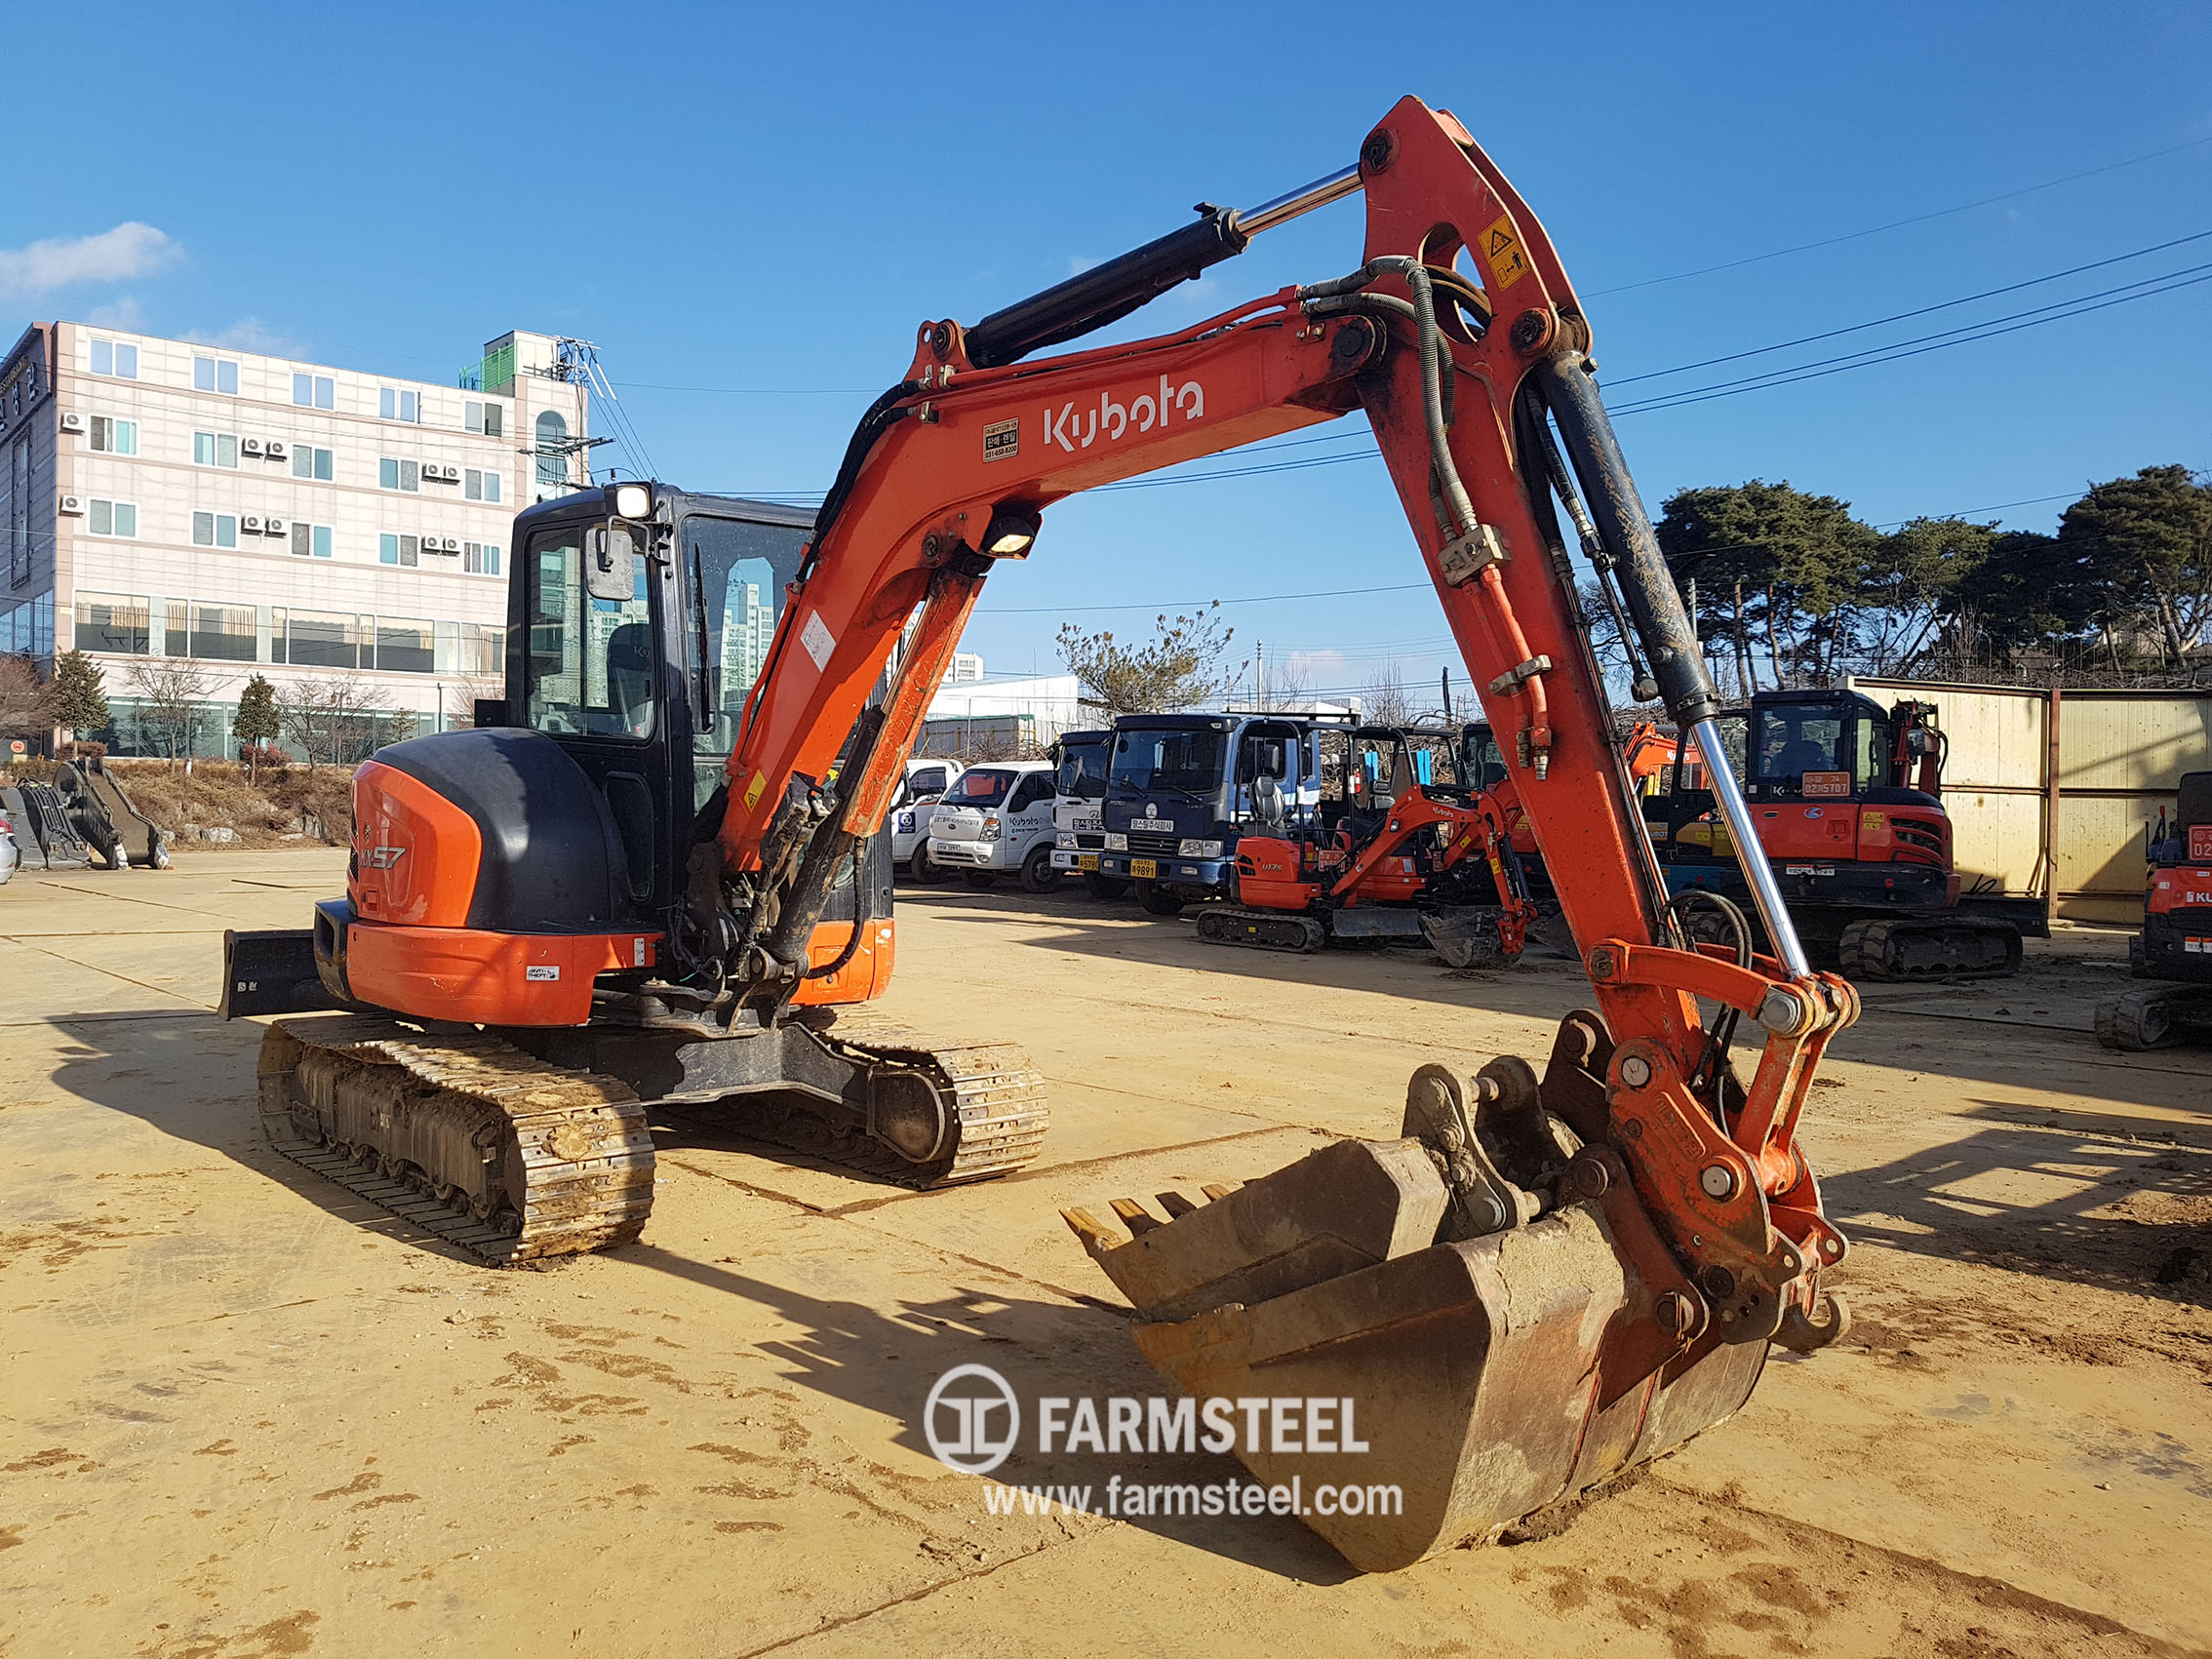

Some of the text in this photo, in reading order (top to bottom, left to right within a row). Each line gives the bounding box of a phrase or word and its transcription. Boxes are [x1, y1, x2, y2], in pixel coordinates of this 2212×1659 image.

[1044, 374, 1204, 453] Kubota
[1433, 806, 1453, 817] Kubota
[1008, 816, 1039, 826] Kubota
